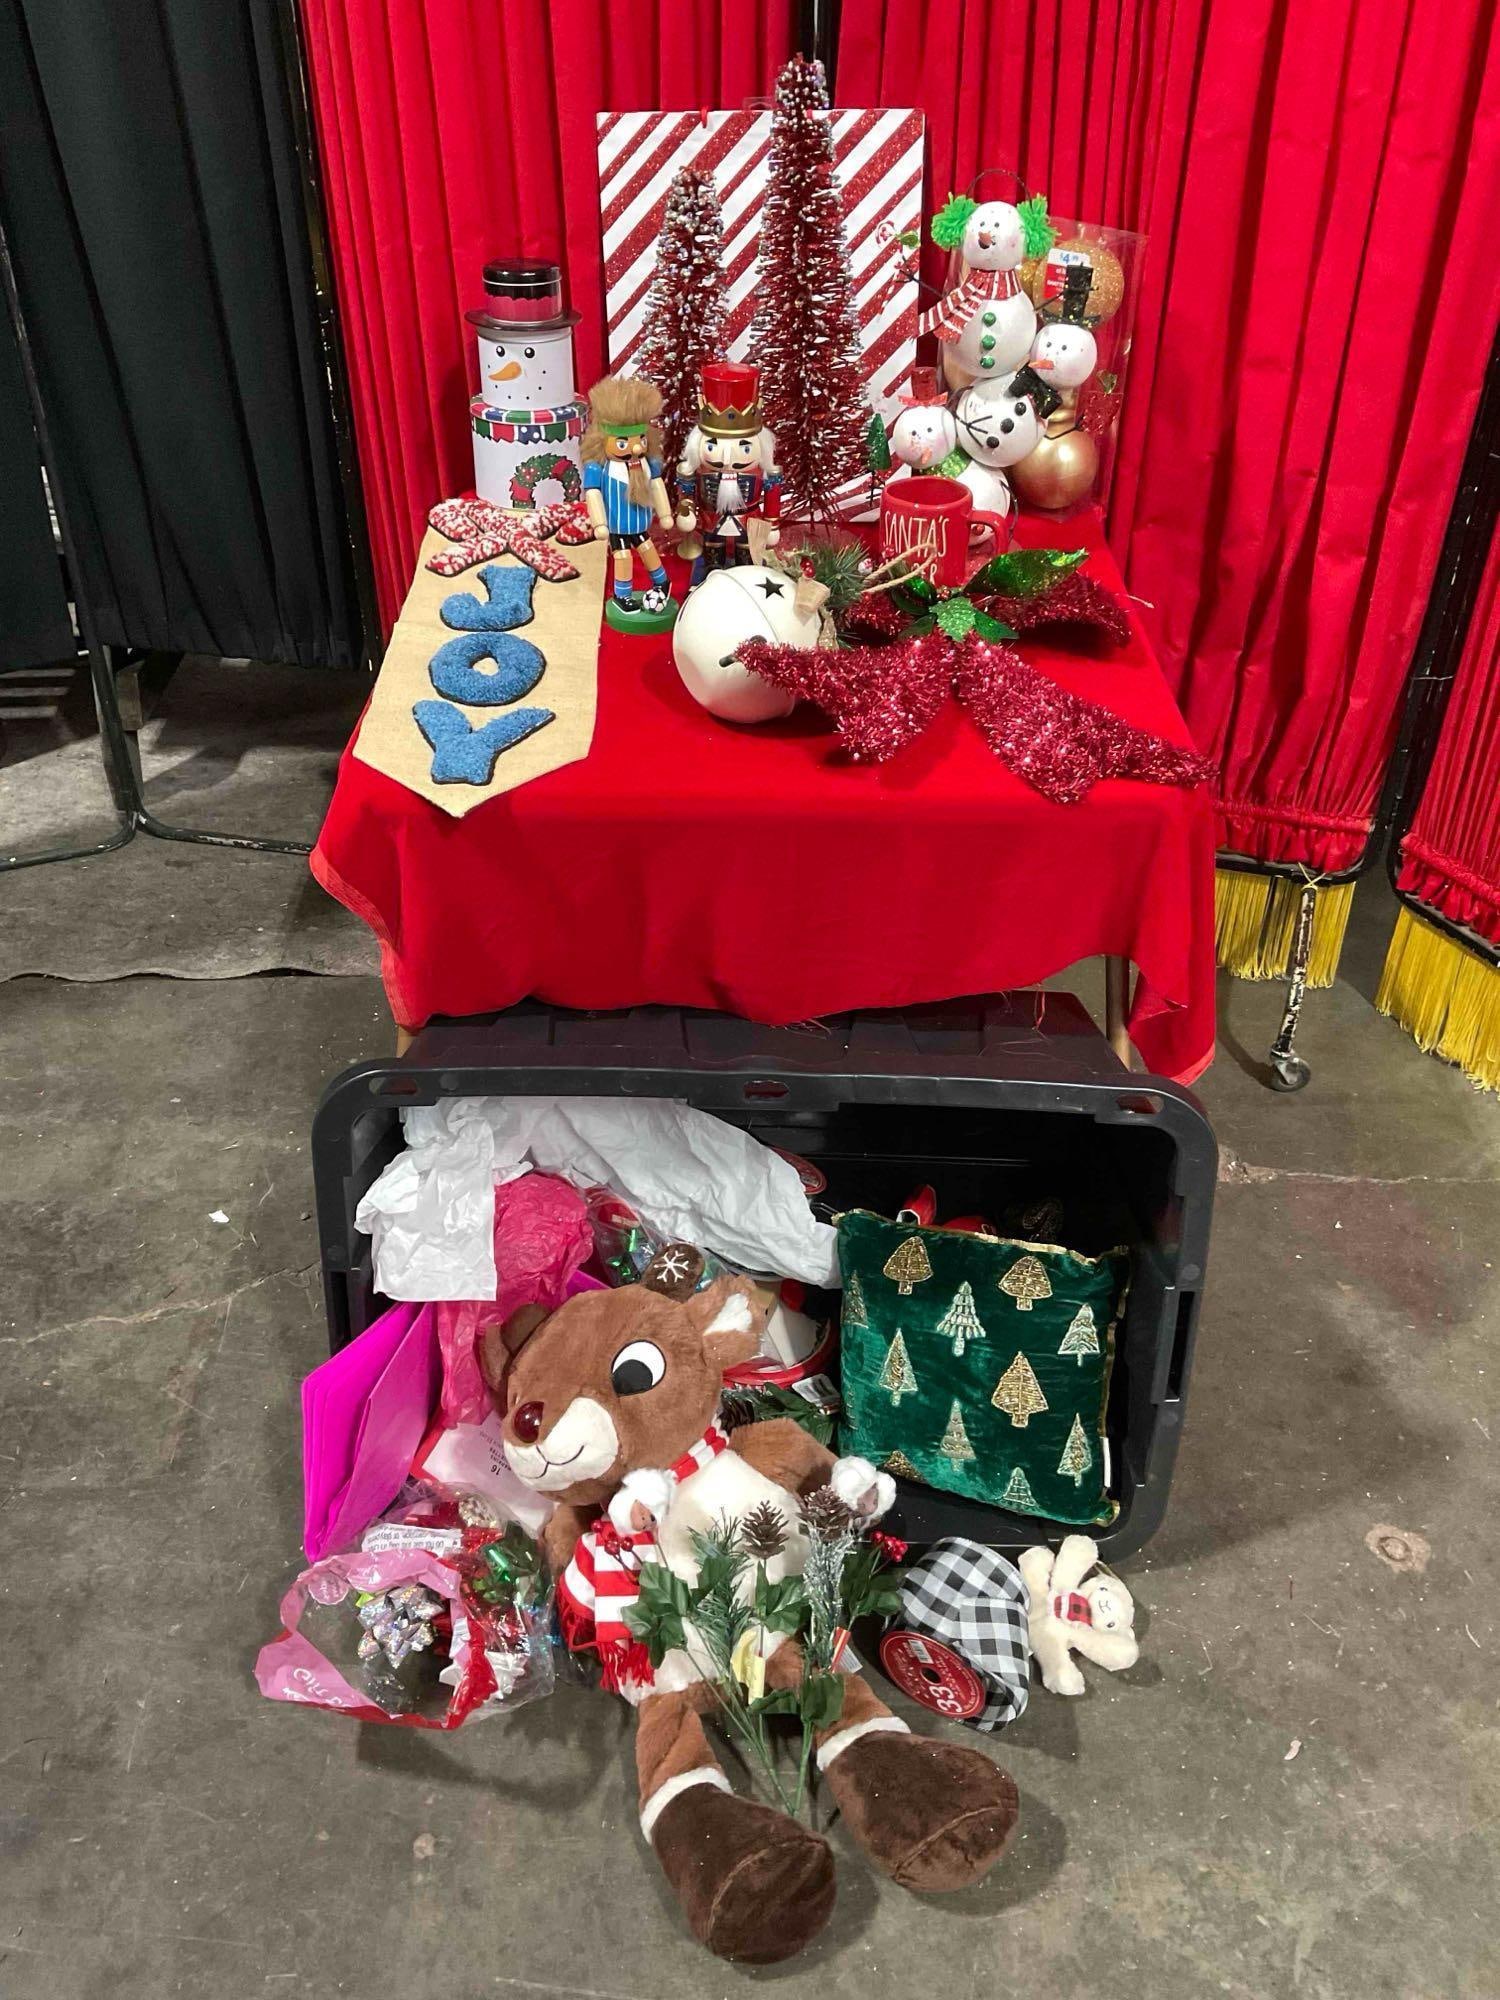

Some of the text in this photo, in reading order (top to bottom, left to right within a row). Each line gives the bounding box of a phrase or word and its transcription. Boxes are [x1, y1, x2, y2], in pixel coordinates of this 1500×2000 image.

[884, 510, 950, 558] SANTA'S
[412, 565, 556, 786] JOY
[491, 1464, 501, 1475] 16
[929, 1685, 963, 1713] 33
